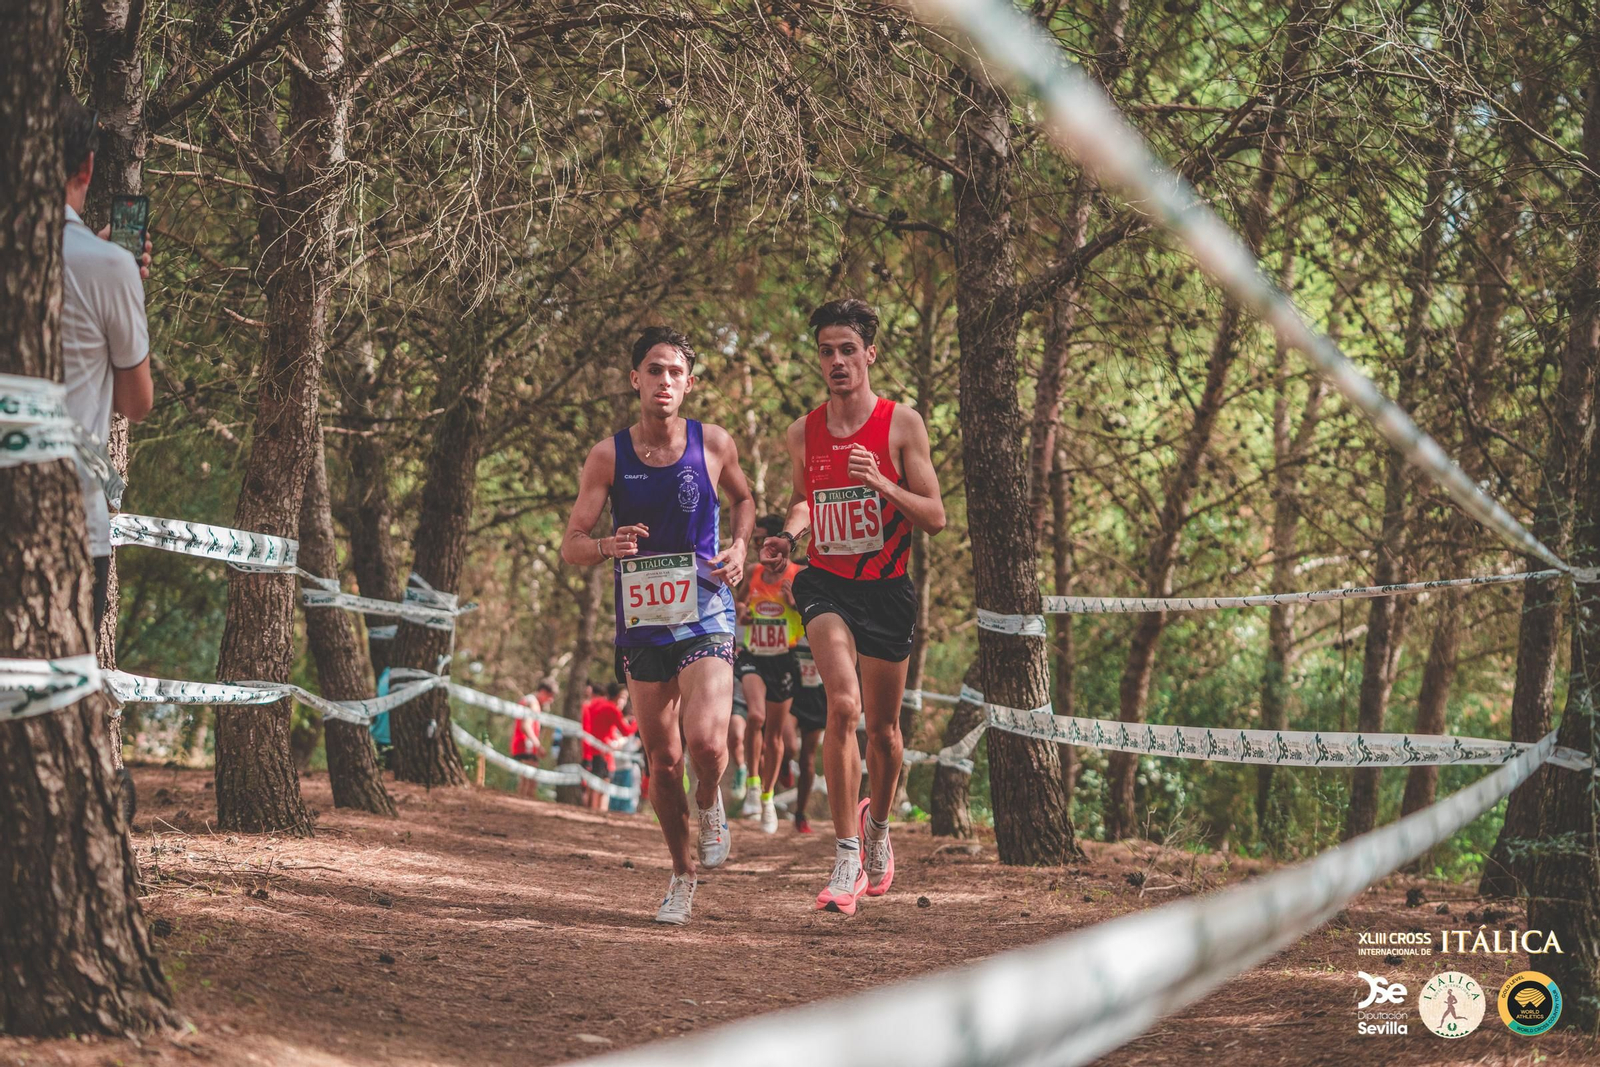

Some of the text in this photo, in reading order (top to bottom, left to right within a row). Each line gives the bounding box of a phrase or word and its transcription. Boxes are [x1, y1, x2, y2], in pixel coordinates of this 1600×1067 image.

[829, 490, 858, 501] ITÁLICA
[815, 499, 880, 542] VIVES
[640, 557, 674, 569] ITÁLICA
[629, 579, 691, 608] 5107
[750, 624, 786, 648] ALBA
